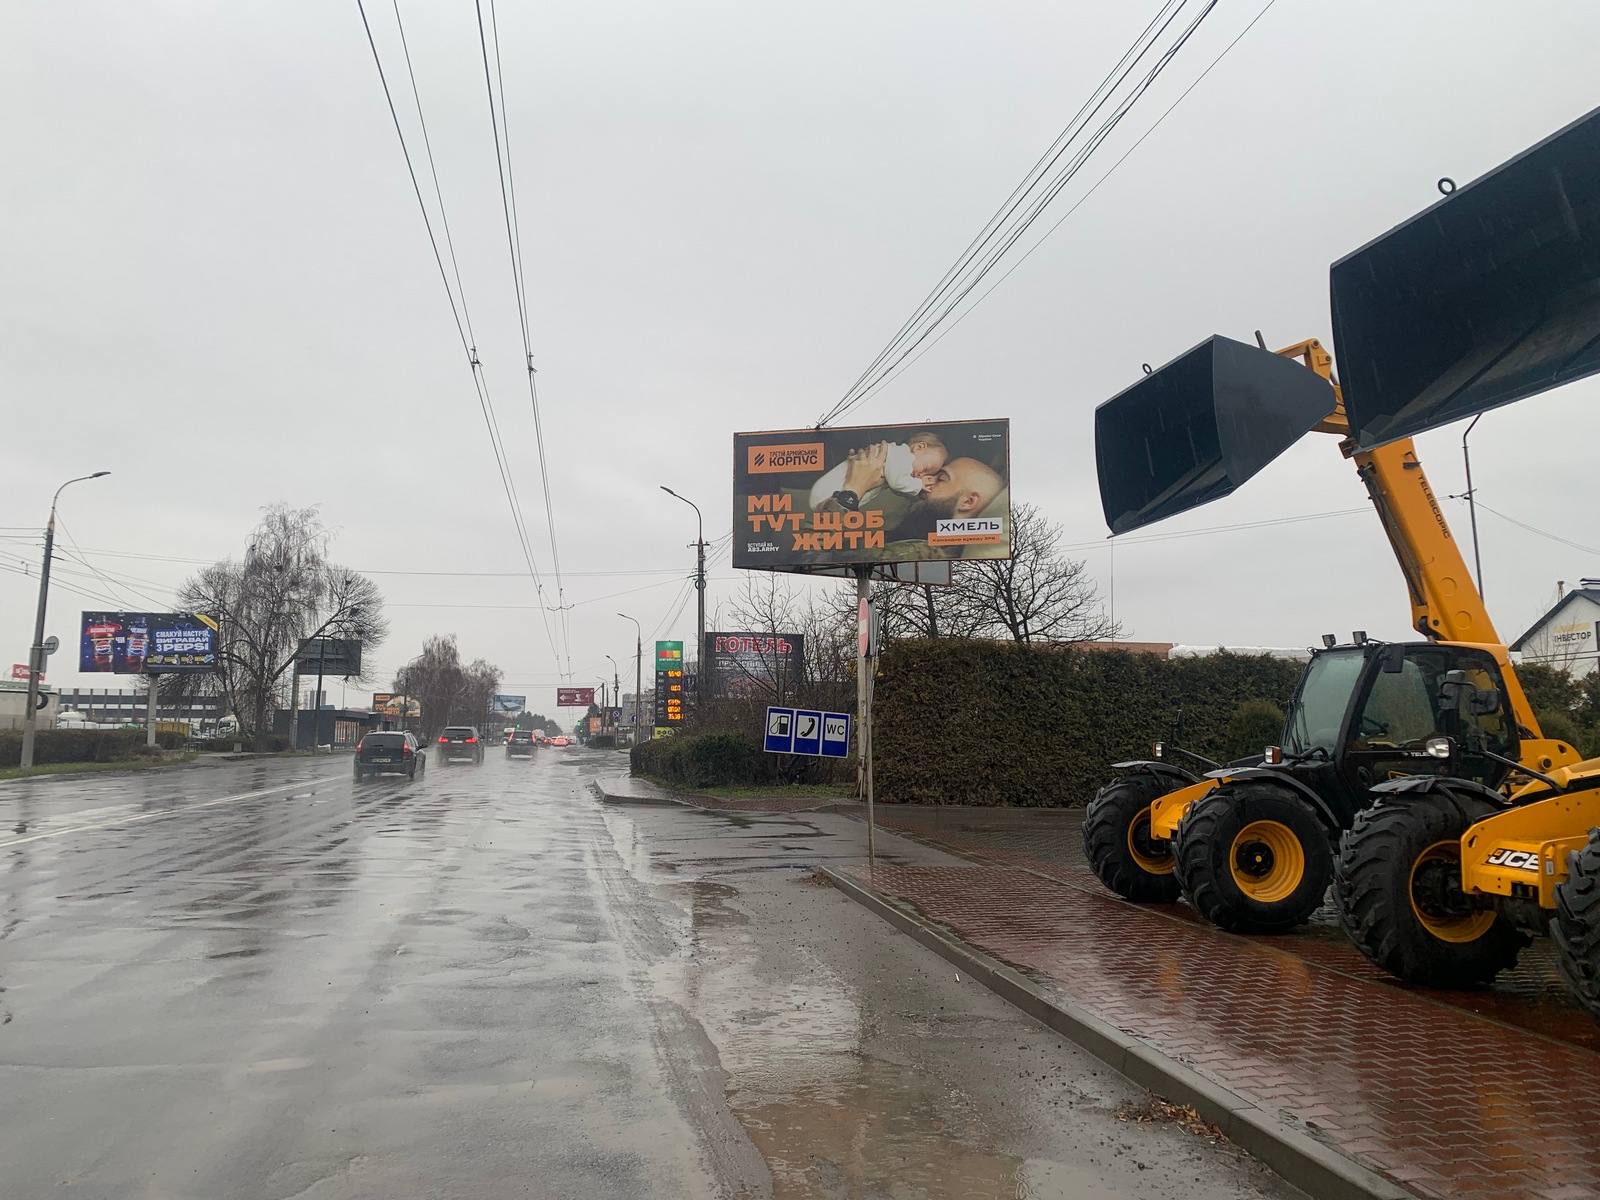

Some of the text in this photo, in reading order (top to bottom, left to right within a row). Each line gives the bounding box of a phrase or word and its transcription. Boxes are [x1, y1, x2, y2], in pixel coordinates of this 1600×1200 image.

[769, 455, 818, 467] КОРПУС
[747, 493, 792, 513] МИ
[1418, 474, 1450, 539] TELESCOPIC
[747, 510, 885, 533] ТУТ ЩОБ
[940, 521, 1000, 532] ХМЕЛЬ
[791, 530, 885, 551] ЖИТИ
[155, 629, 182, 638] СМАКУЙ
[1554, 631, 1592, 642] ІНВЕСТОР
[163, 643, 209, 652] PEPSI
[715, 636, 793, 653] ГОТЕЛЬ
[826, 724, 845, 736] WC
